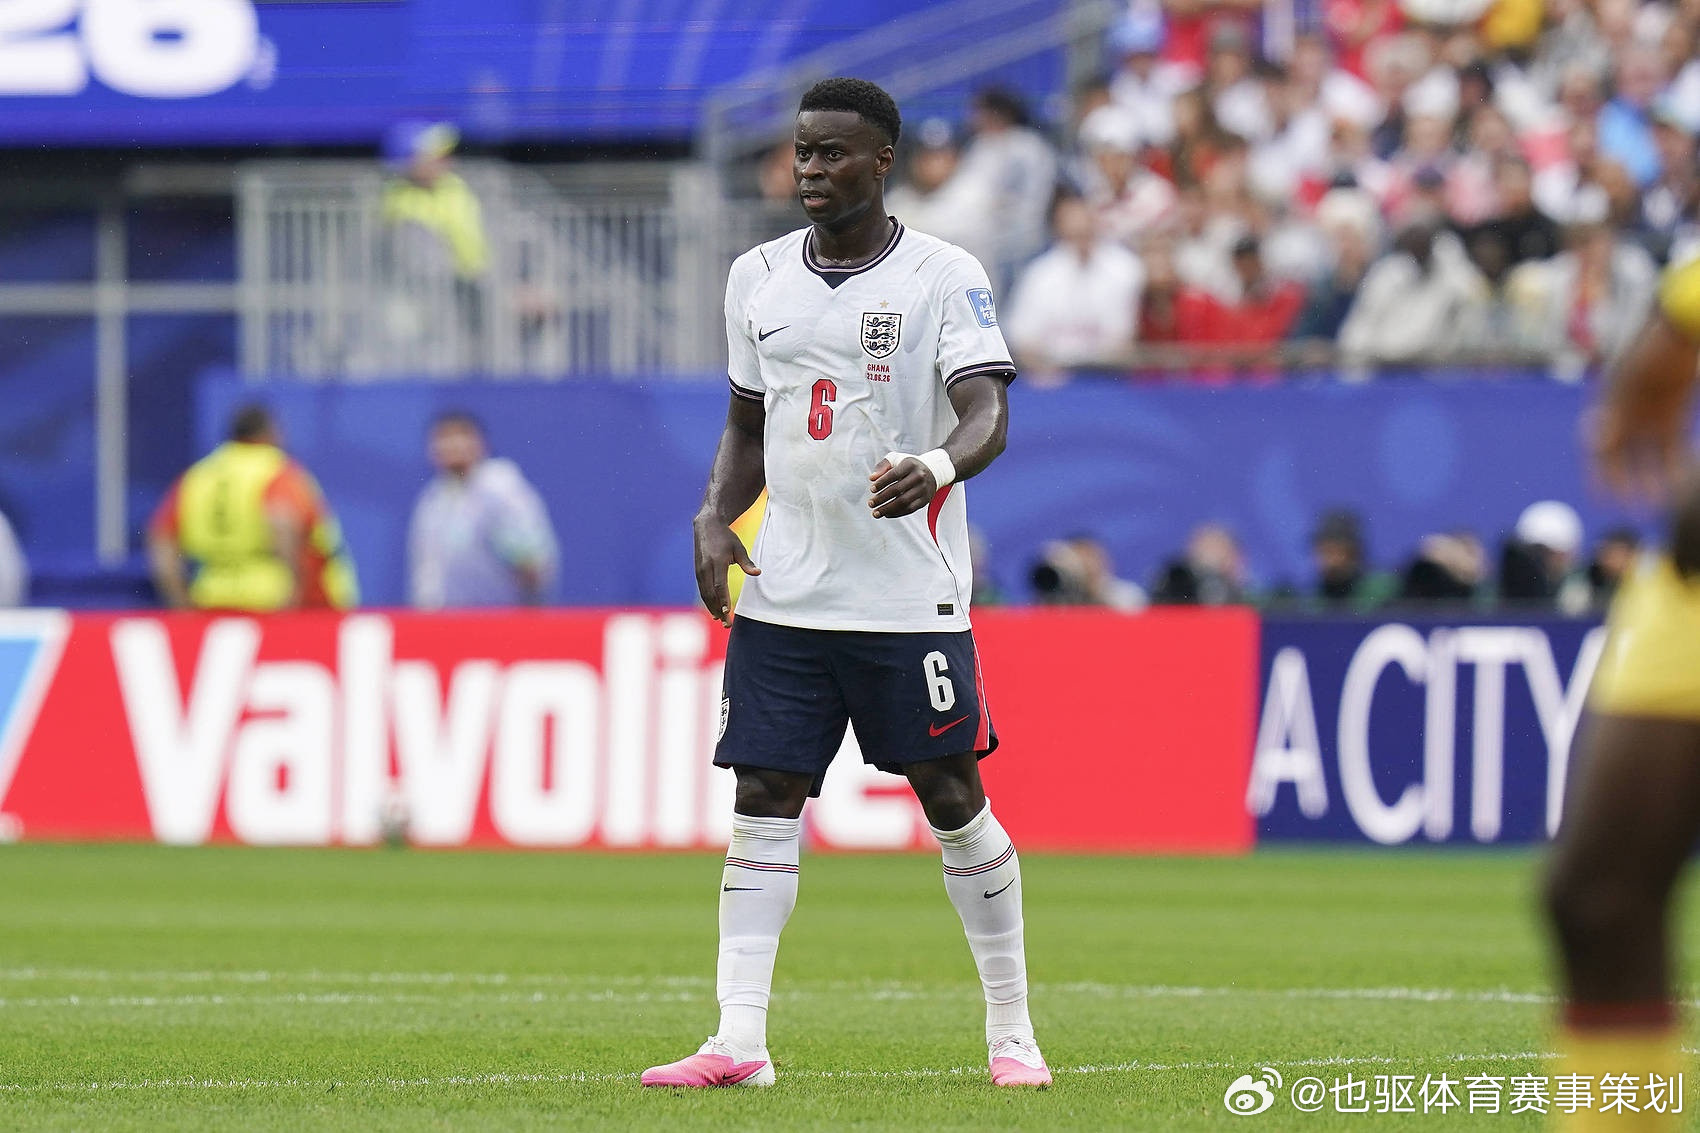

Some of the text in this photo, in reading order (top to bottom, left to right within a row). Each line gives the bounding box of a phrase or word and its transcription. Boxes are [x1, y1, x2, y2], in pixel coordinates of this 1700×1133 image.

[866, 363, 890, 373] GHANA
[808, 378, 837, 441] 6
[922, 650, 956, 712] 6
[1246, 623, 1606, 845] A CITY
